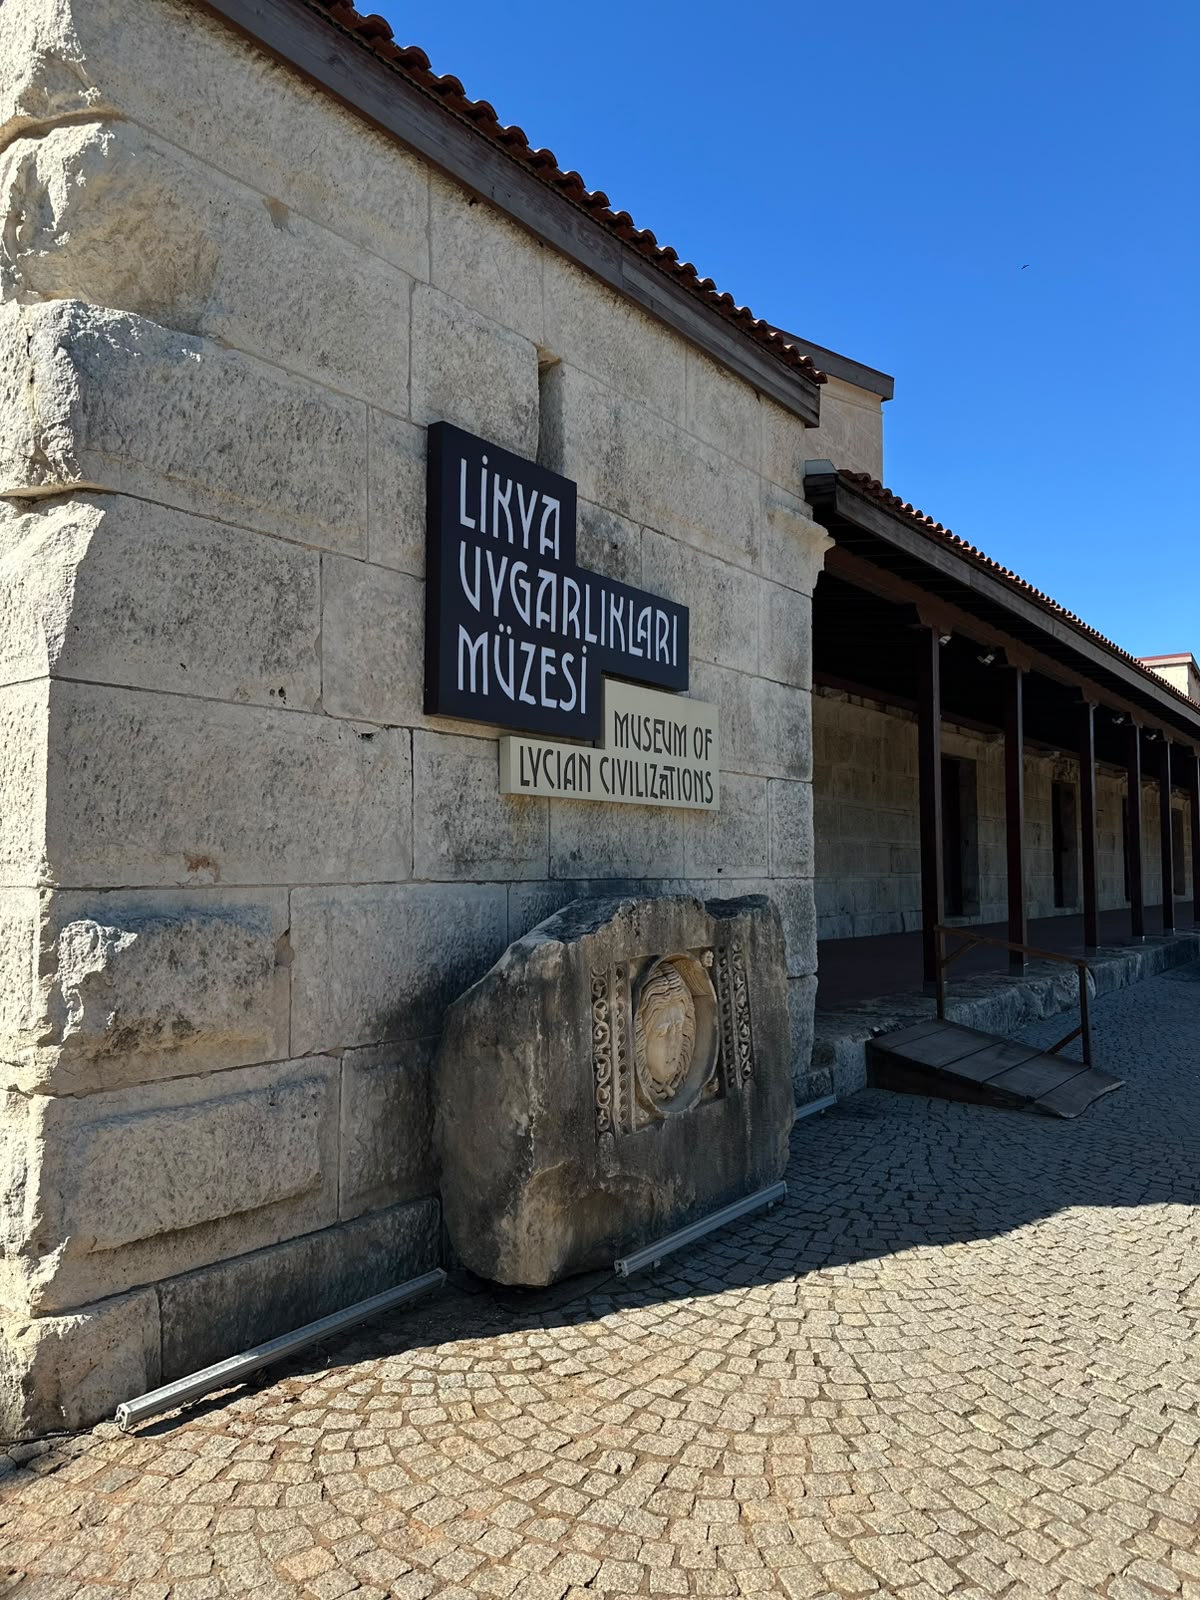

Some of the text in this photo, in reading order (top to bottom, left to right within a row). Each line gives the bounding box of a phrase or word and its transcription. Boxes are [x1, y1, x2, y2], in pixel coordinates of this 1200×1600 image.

[459, 455, 560, 560] LİKYA
[459, 540, 678, 667] UYGARLIKLARI
[457, 623, 587, 715] MÜZESİ
[519, 745, 713, 804] LYCIAN CIVILIZATIONS
[614, 710, 713, 761] MUSEUM OF
